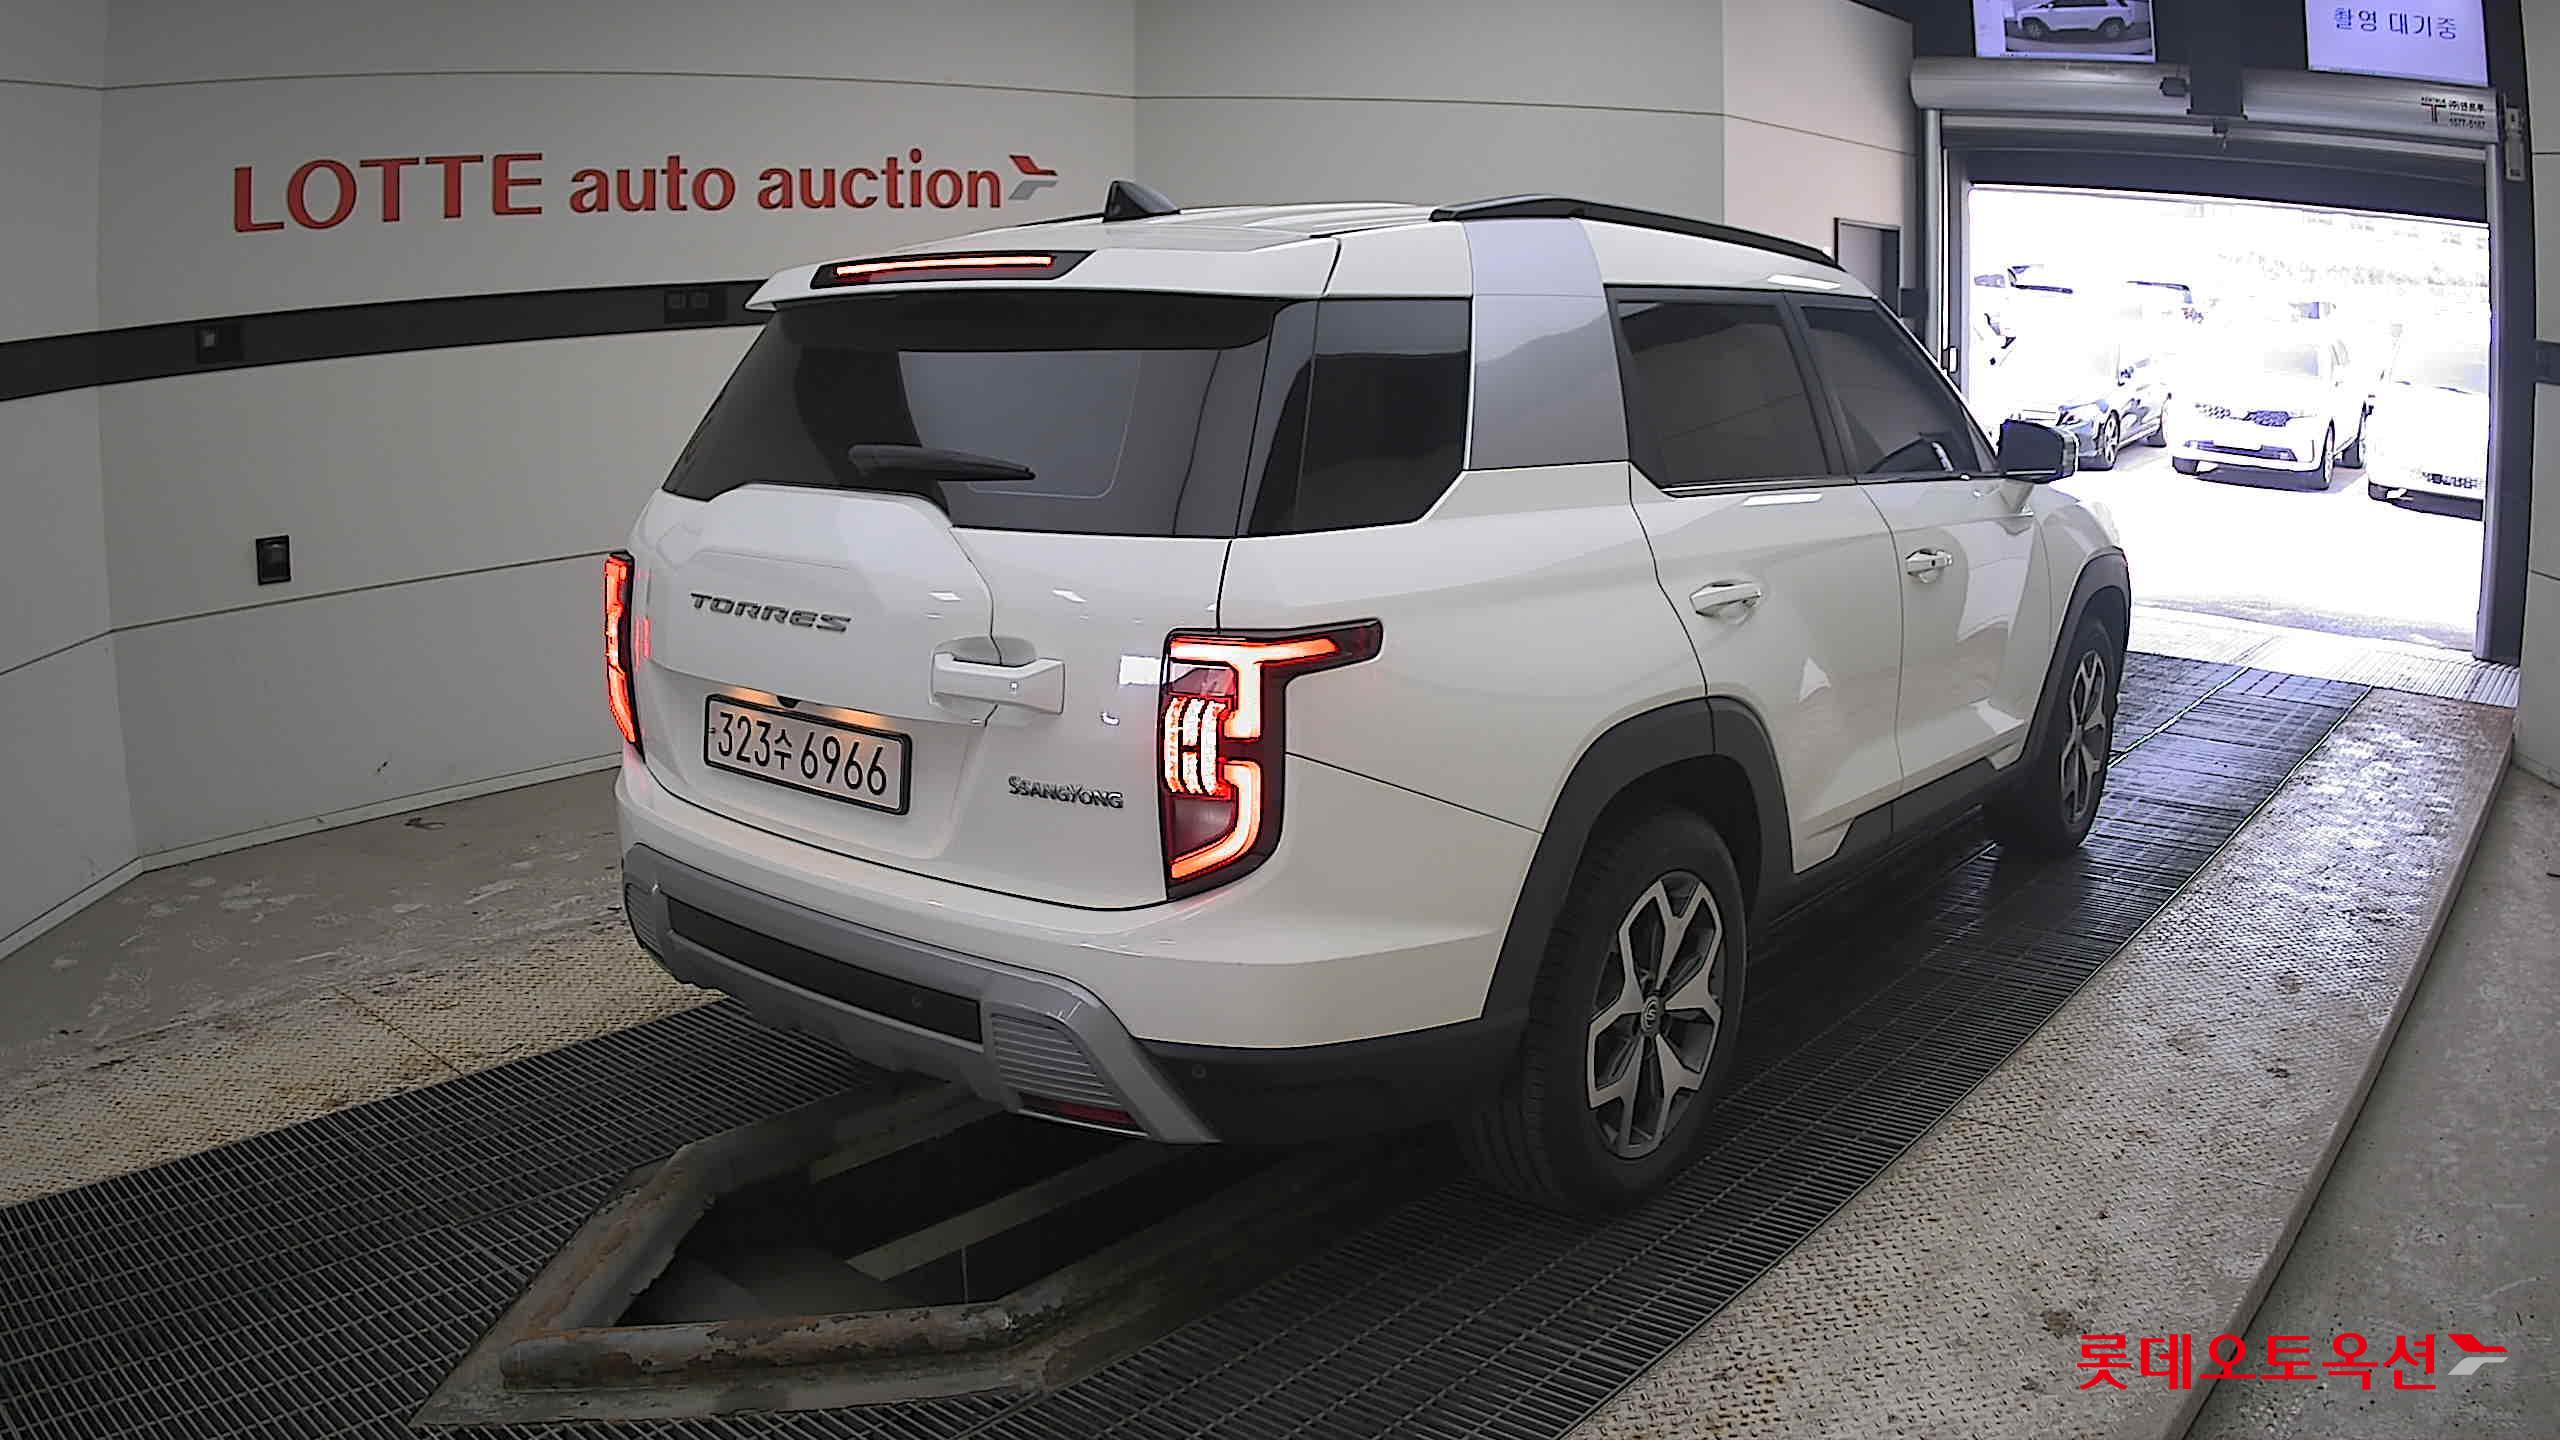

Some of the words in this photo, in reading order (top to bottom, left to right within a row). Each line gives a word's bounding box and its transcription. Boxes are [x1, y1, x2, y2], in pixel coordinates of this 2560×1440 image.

[2335, 7, 2377, 32] 촬영
[2389, 13, 2457, 40] 대기중
[234, 152, 542, 232] LOTTE
[569, 155, 736, 213] auto
[757, 148, 1001, 209] auction
[690, 592, 852, 633] TORRES
